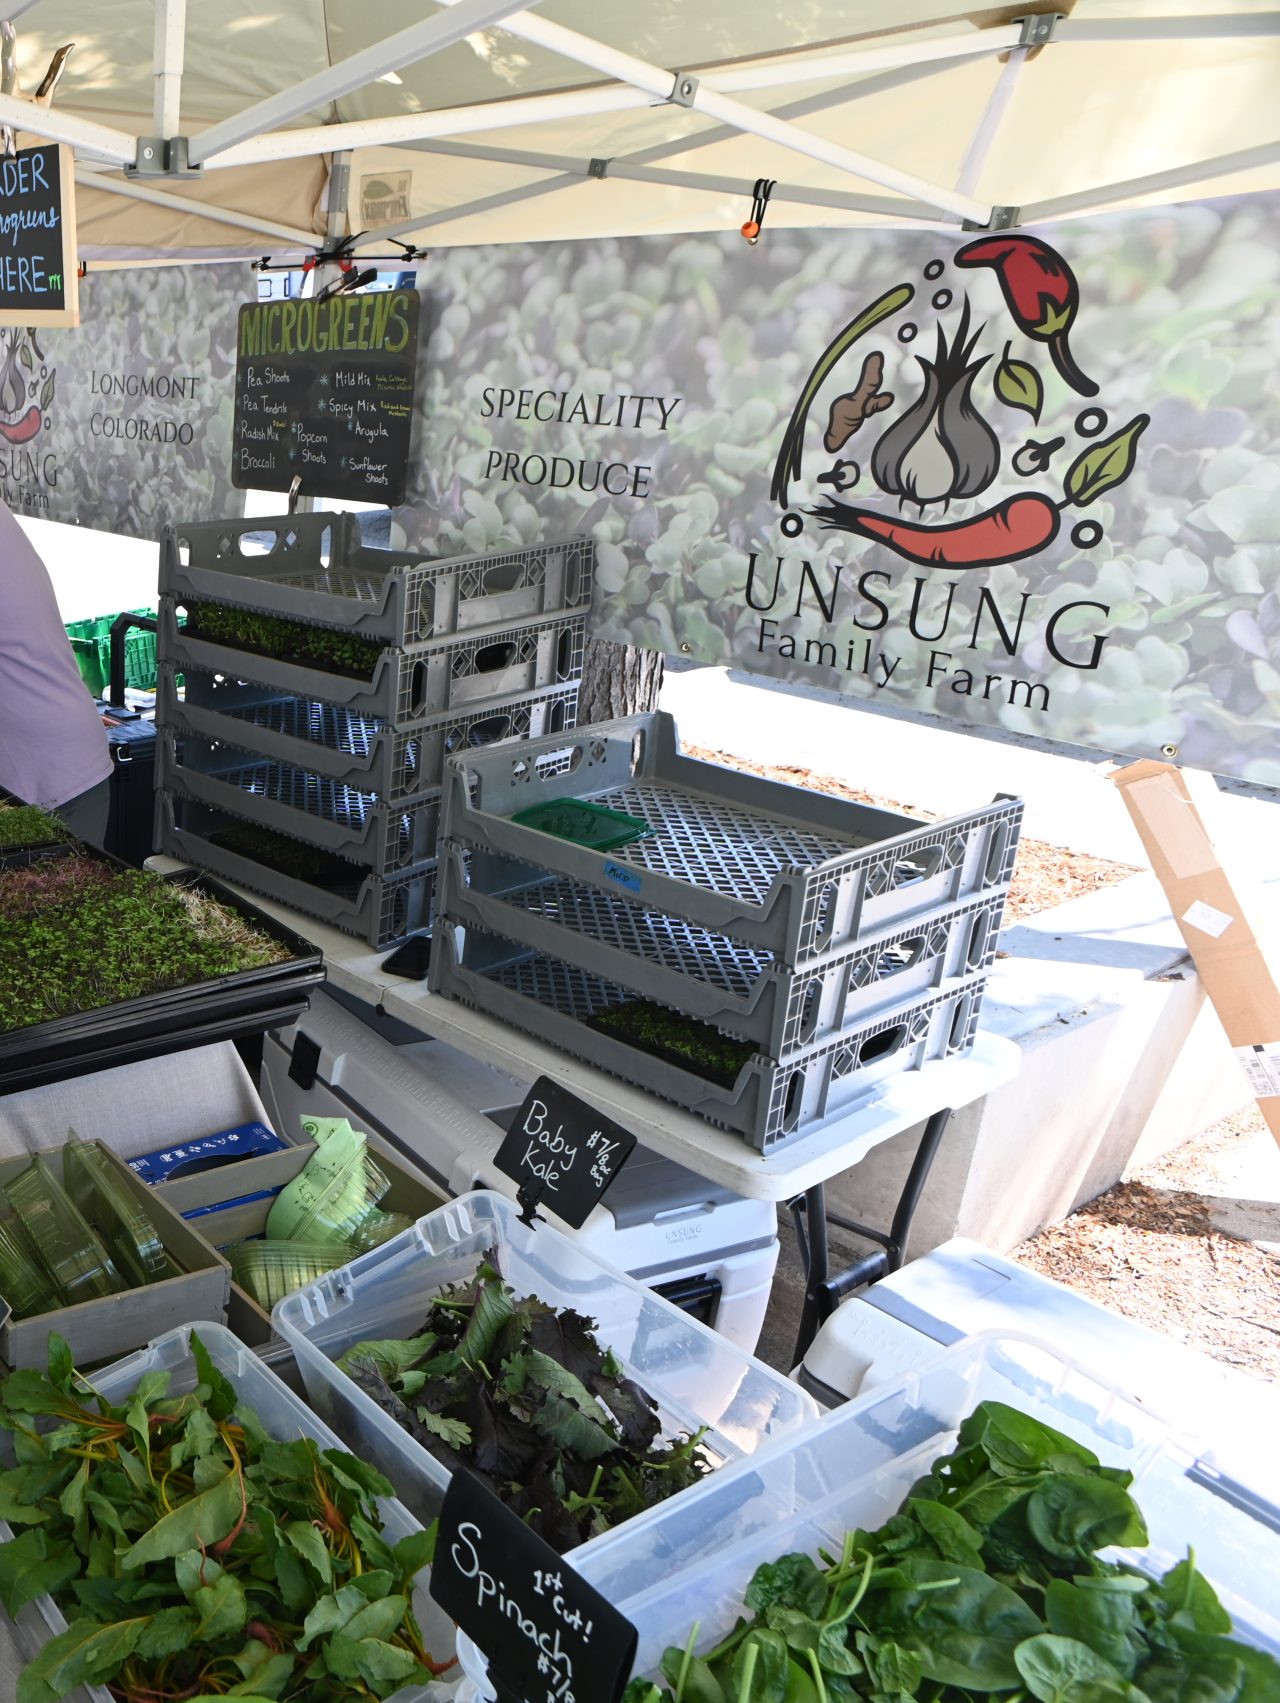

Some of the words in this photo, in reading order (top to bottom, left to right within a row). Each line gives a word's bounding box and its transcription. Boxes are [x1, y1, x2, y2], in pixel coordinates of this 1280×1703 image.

[240, 293, 409, 357] MICROGREENS
[91, 370, 200, 400] LONGMONT
[248, 367, 263, 388] Pea
[265, 367, 290, 384] Shoots
[336, 371, 355, 388] Mild
[358, 372, 371, 387] Mix
[243, 394, 258, 411] Pea
[260, 395, 287, 414] Tendrils
[329, 398, 353, 419] Spicy
[357, 400, 376, 412] Mix
[480, 387, 683, 431] SPECIALITY
[90, 412, 193, 445] COLORADO
[241, 420, 265, 440] Radish
[267, 425, 279, 441] Mix
[297, 423, 327, 446] Popcorn
[355, 420, 388, 443] Arugula
[241, 448, 275, 470] Broccoli
[302, 448, 326, 464] Shoots
[349, 457, 388, 470] Sunflower
[365, 473, 388, 485] Shoots
[484, 450, 651, 498] PRODUCE
[19, 485, 49, 509] Farm
[745, 553, 1111, 670] UNSUNG
[757, 618, 902, 688] Family
[925, 650, 1051, 711] Farm
[523, 1100, 577, 1170] Baby
[520, 1140, 560, 1191] Kale
[533, 1569, 563, 1595] 1st
[451, 1521, 572, 1678] Spinach
[553, 1595, 593, 1643] Cut!
